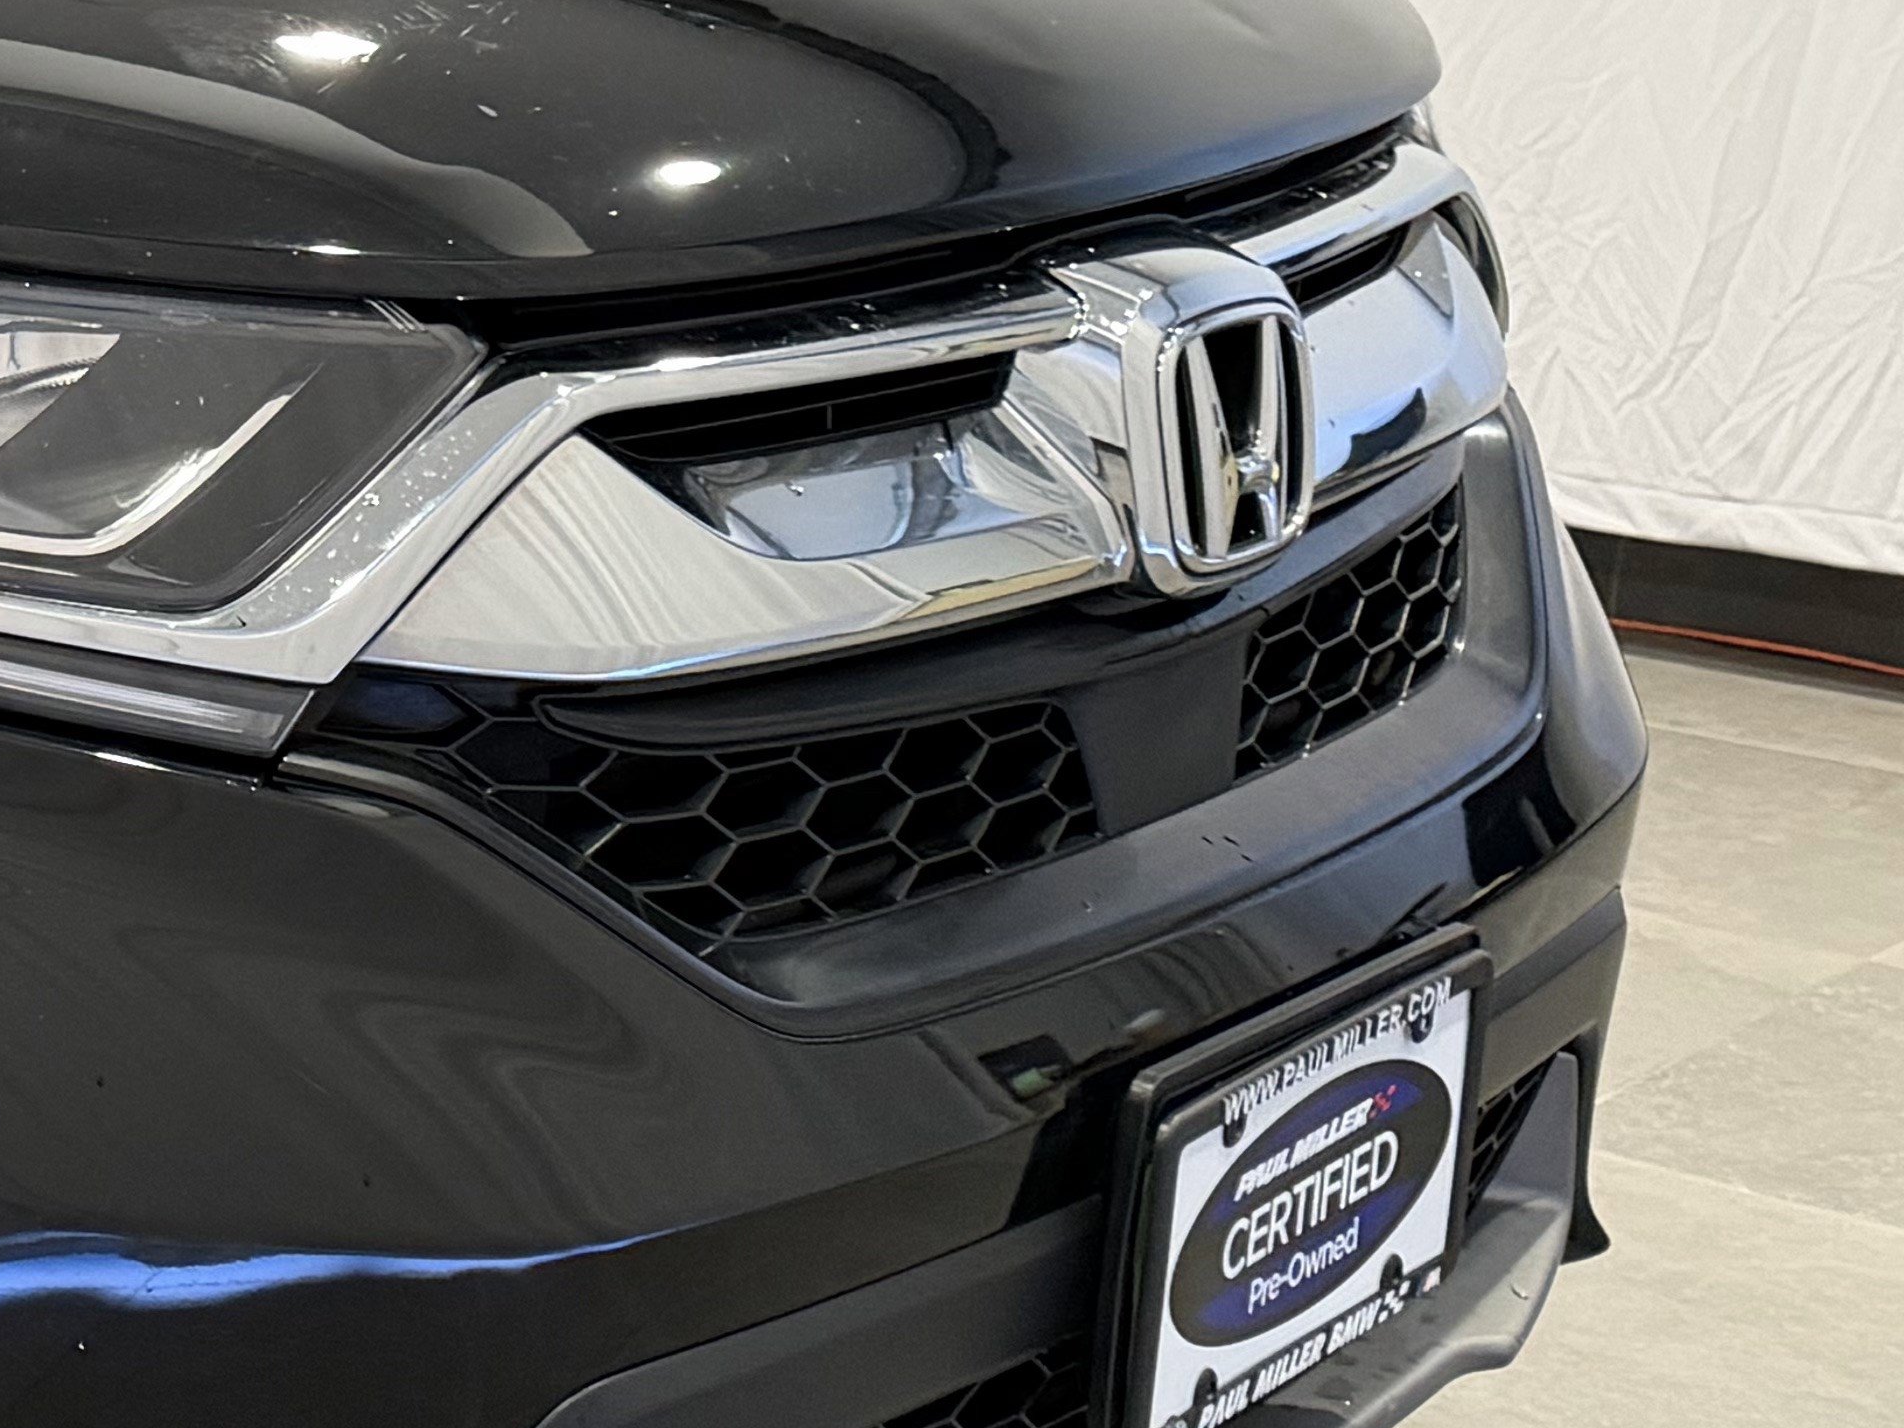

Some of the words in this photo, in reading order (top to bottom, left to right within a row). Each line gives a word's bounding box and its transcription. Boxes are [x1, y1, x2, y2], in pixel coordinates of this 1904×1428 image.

[1222, 976, 1452, 1125] WWW.PAULMILLER.COM
[1233, 1147, 1291, 1202] PAUL
[1289, 1097, 1374, 1170] MILLER
[1222, 1130, 1399, 1280] CERTIFIED
[1248, 1215, 1360, 1315] Pre-Owned
[1251, 1332, 1327, 1403] MILLER
[1326, 1298, 1382, 1354] BMW
